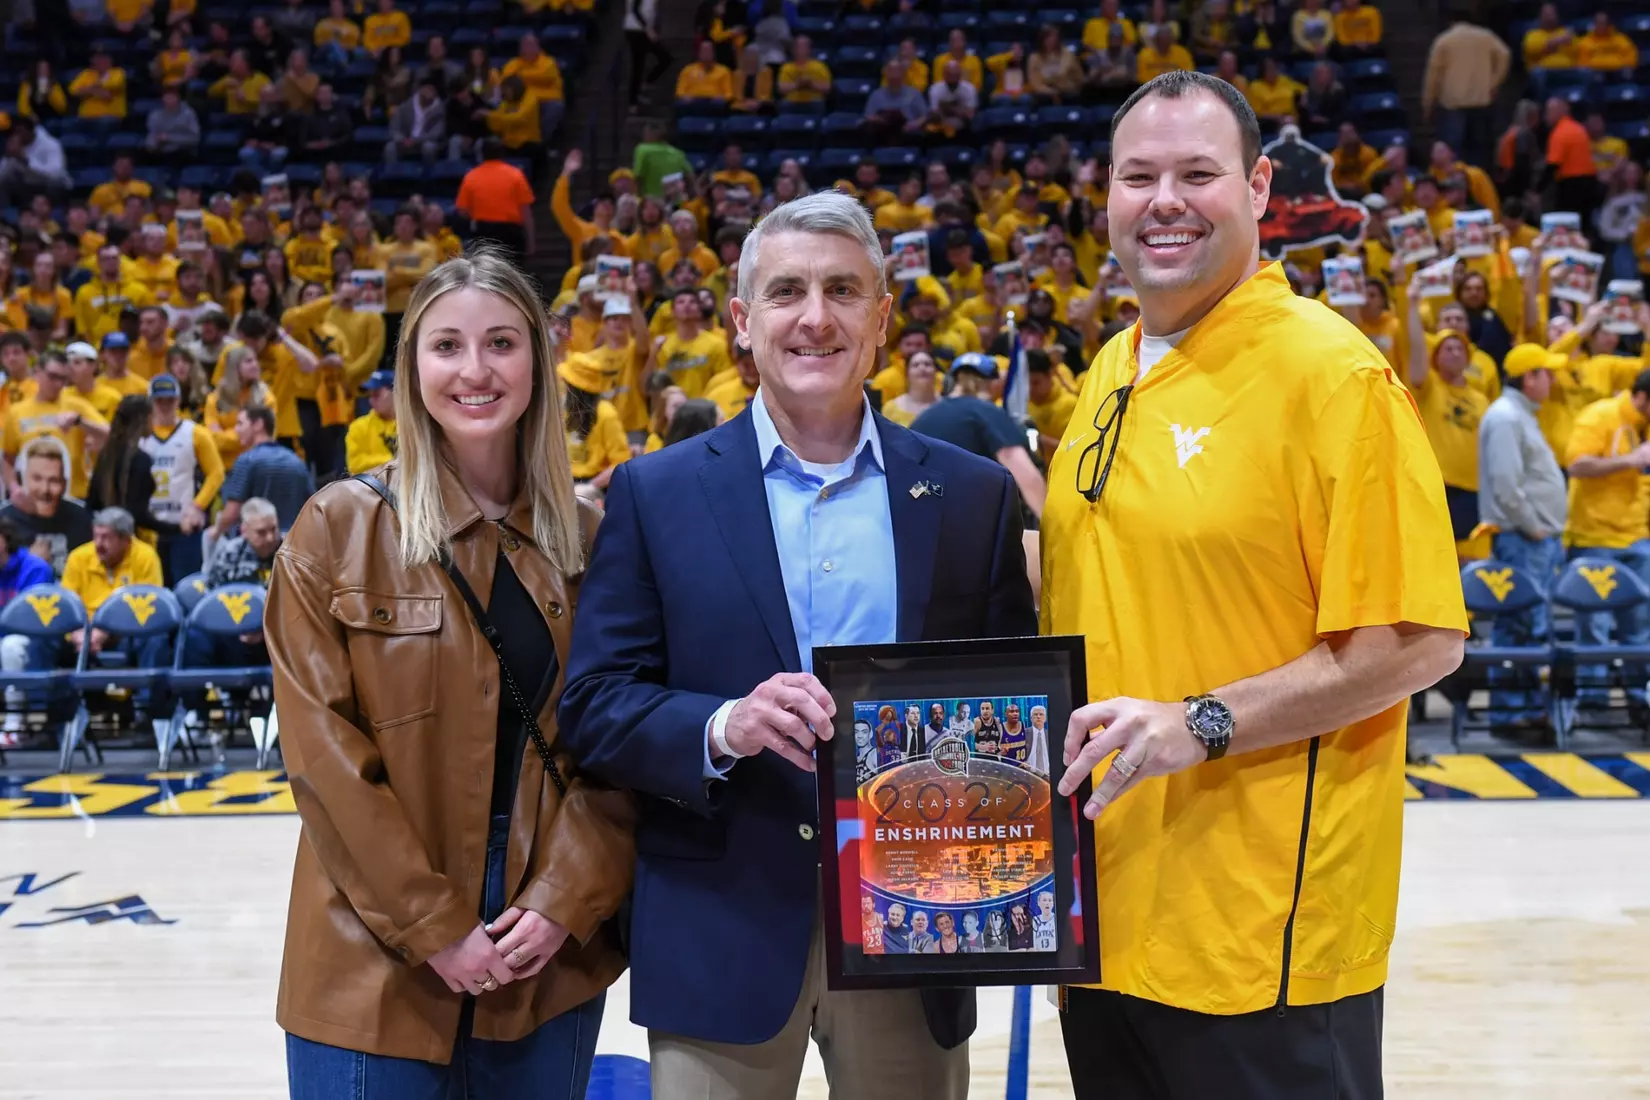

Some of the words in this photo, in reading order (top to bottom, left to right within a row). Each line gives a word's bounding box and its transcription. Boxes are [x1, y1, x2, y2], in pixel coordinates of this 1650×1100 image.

[874, 780, 1033, 824] 2022
[904, 798, 965, 809] CLASS
[980, 797, 1003, 807] OF
[875, 825, 1035, 841] ENSHRINEMENT
[867, 935, 882, 948] 23
